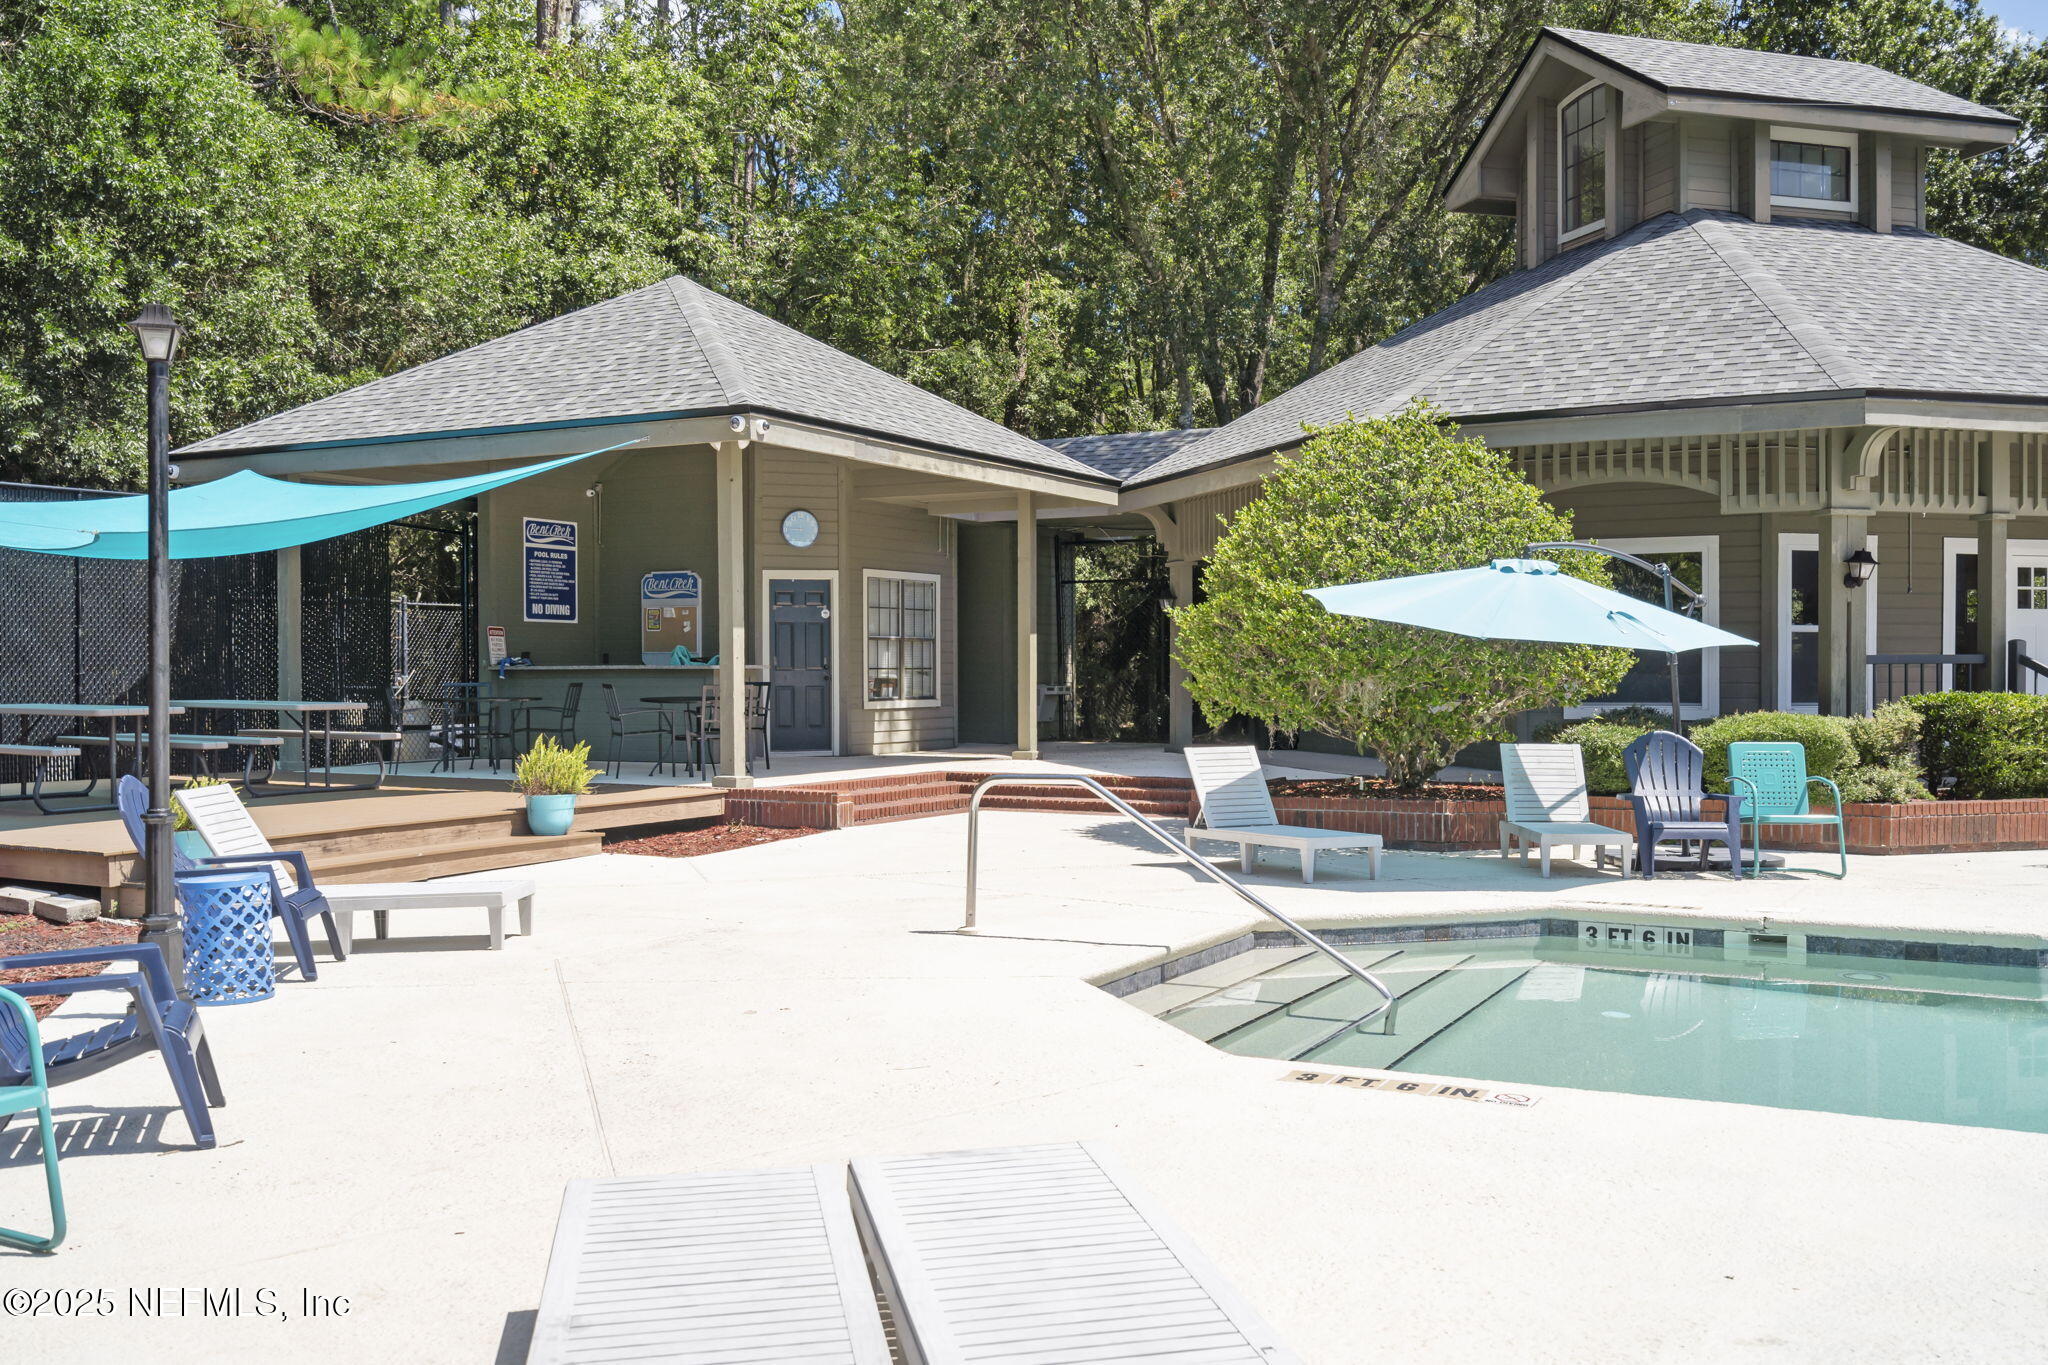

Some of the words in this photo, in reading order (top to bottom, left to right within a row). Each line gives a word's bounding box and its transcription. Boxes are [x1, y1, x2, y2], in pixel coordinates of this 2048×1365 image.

[527, 523, 549, 536] Bent
[549, 524, 573, 538] Creek
[645, 578, 669, 591] Bent
[669, 577, 694, 591] Creek
[532, 603, 544, 614] NO
[545, 604, 570, 615] DIVING
[1586, 926, 1598, 938] 3
[1608, 928, 1632, 941] FT
[1643, 930, 1655, 942] 6
[1668, 931, 1690, 944] IN
[1295, 1073, 1319, 1082] 3
[1335, 1076, 1381, 1088] FT.
[1396, 1082, 1420, 1092] 6
[1438, 1086, 1480, 1099] IN.
